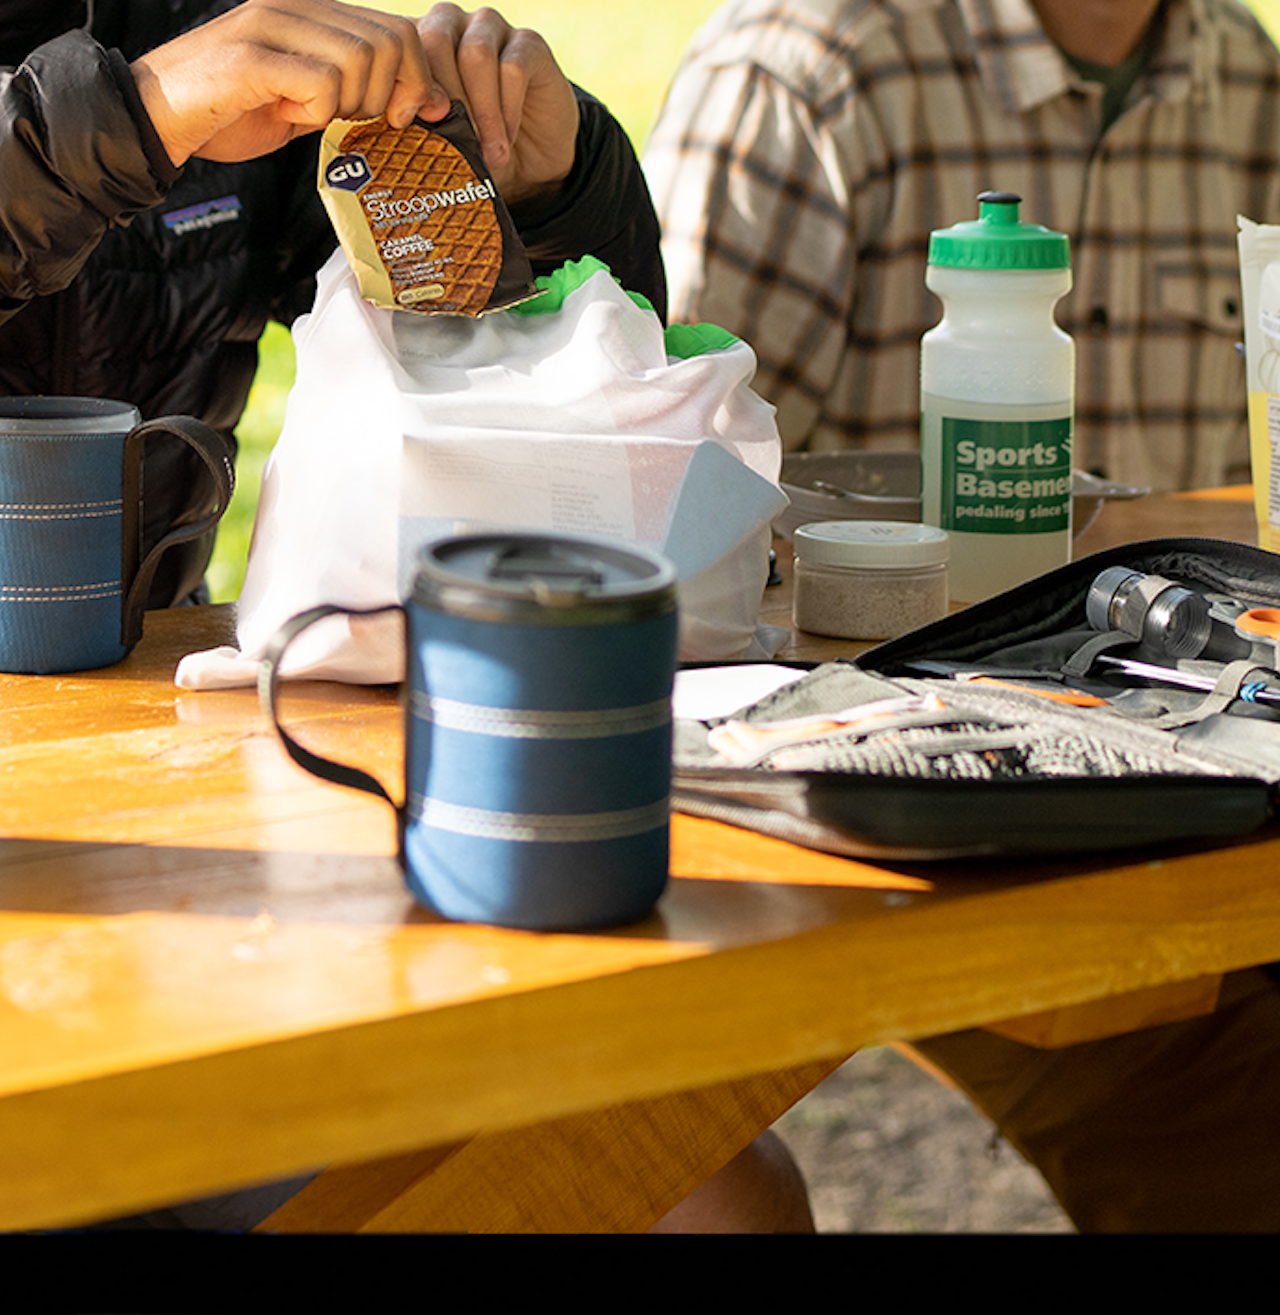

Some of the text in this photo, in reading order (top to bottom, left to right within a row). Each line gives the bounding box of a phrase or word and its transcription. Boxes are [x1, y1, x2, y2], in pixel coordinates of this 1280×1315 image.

[328, 161, 366, 183] GU
[366, 179, 496, 222] Stroopwafel
[380, 233, 423, 250] CARAMEL
[383, 239, 435, 259] COFFEE
[956, 440, 1058, 471] Sports
[956, 504, 1025, 522] pedaling
[1030, 503, 1061, 518] since
